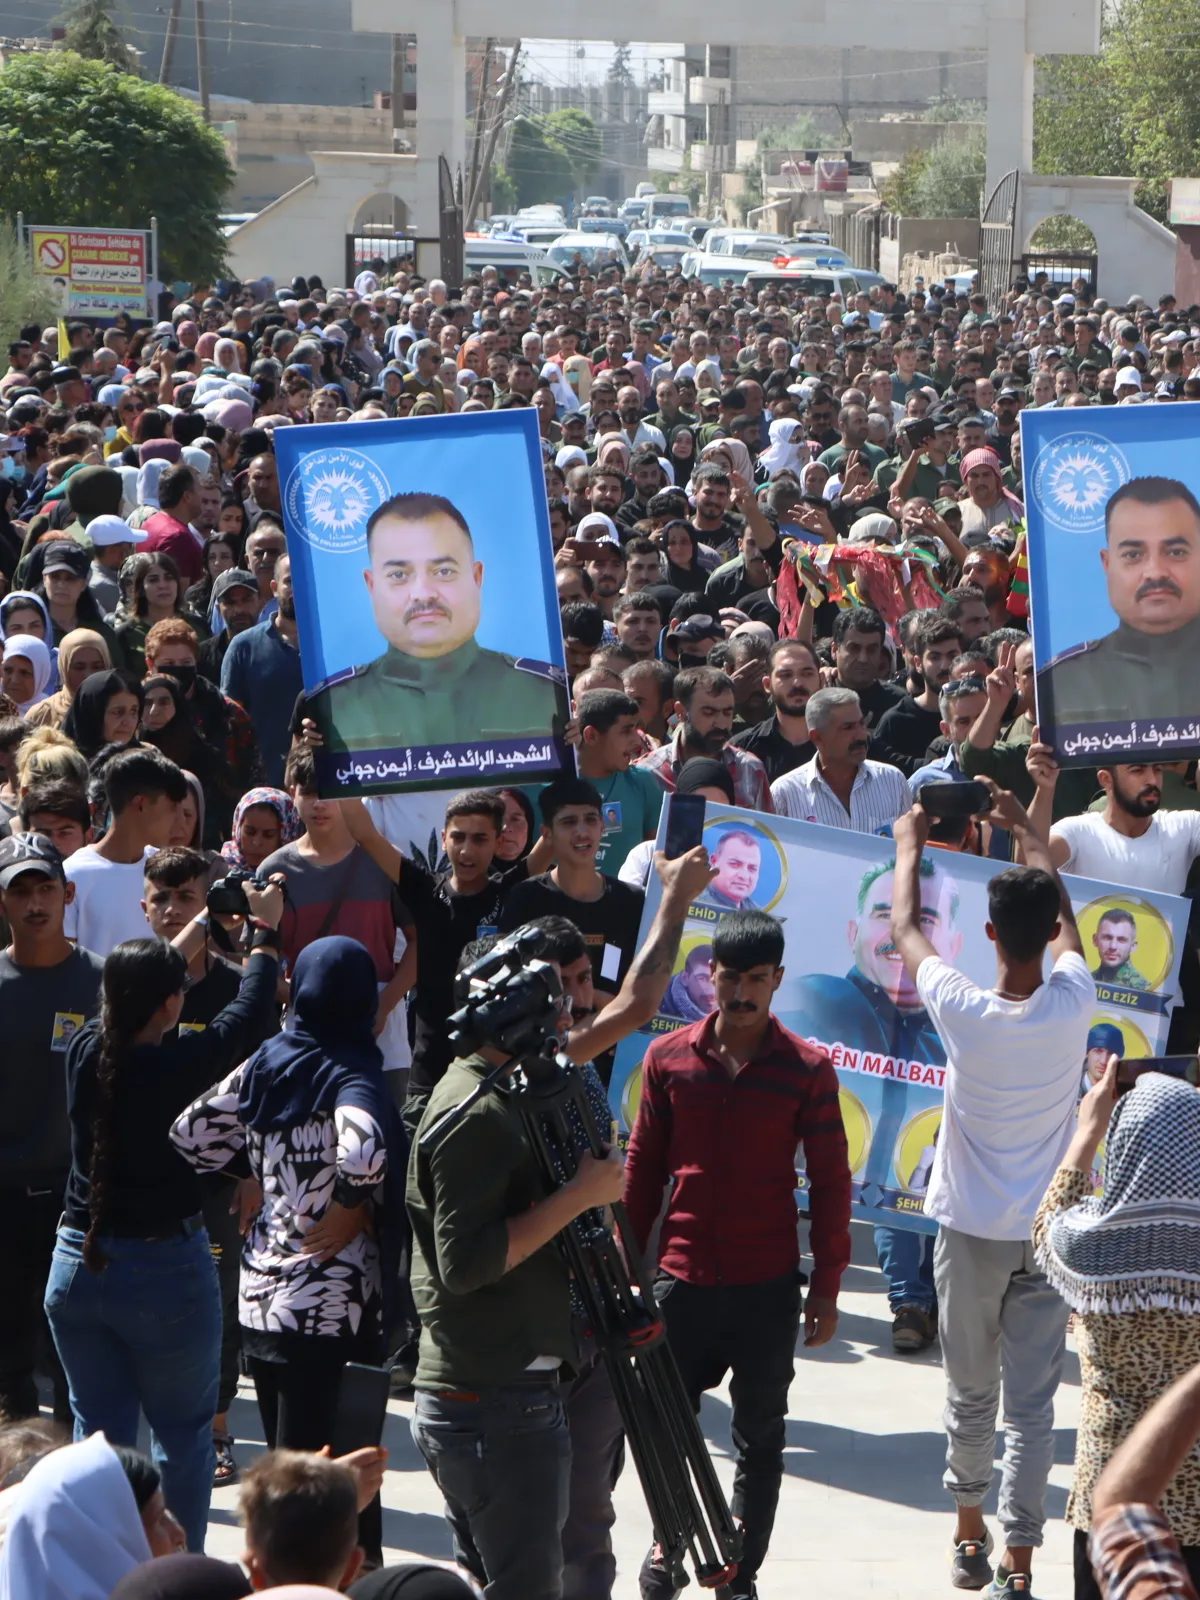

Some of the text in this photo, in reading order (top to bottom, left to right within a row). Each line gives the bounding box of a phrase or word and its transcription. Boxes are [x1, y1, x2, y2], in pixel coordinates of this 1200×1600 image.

[1063, 732, 1101, 756] جولي
[1102, 722, 1137, 749] أيمن
[376, 748, 412, 778] أيمن
[458, 749, 495, 771] الرائد
[495, 744, 551, 769] الشهيد
[335, 760, 376, 785] جولي
